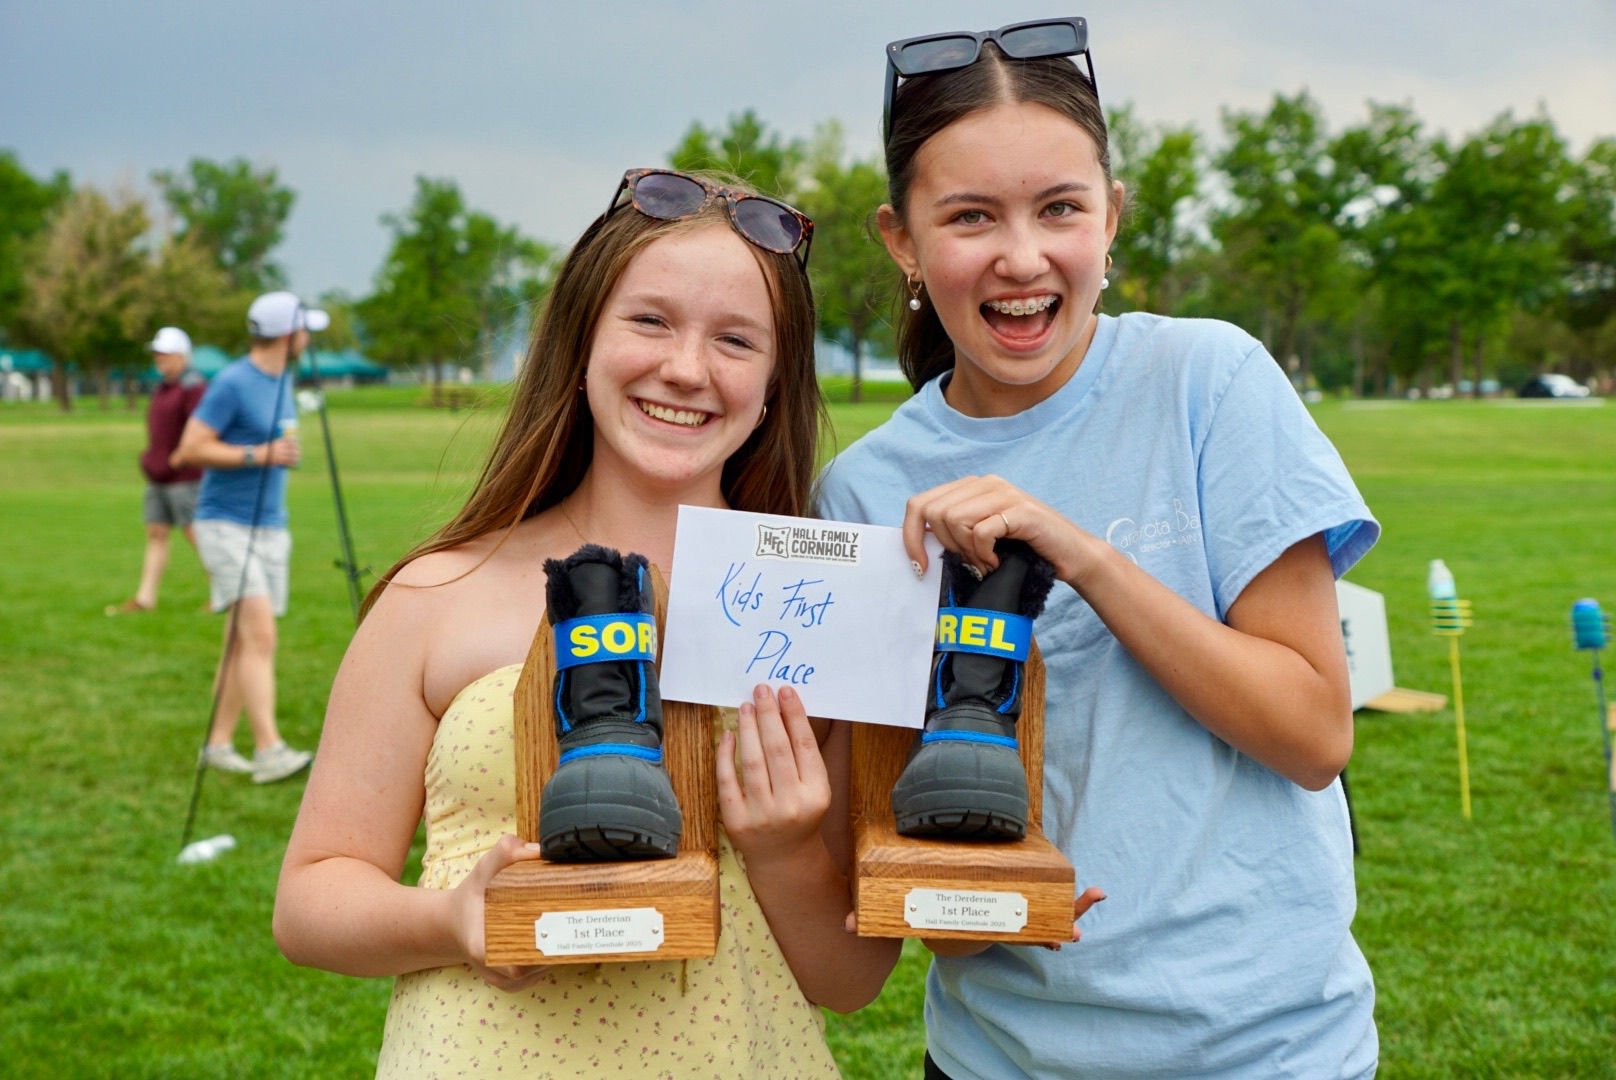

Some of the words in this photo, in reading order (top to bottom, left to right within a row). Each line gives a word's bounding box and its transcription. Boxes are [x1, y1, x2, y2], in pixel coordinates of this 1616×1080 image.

[764, 531, 784, 554] HFC
[793, 528, 818, 540] HALL
[821, 530, 859, 543] FAMILY
[791, 540, 858, 558] CORNHOLE
[716, 562, 763, 626] Kids
[780, 579, 834, 627] First
[570, 621, 656, 657] SOR
[936, 614, 1015, 652] REL
[745, 630, 815, 684] Place
[936, 893, 952, 902] The
[954, 894, 997, 904] Derderian
[566, 916, 583, 925] The
[586, 914, 631, 924] Derderian
[942, 906, 957, 916] 1st
[961, 906, 990, 917] Place
[574, 929, 590, 939] 1st
[594, 927, 625, 938] Place
